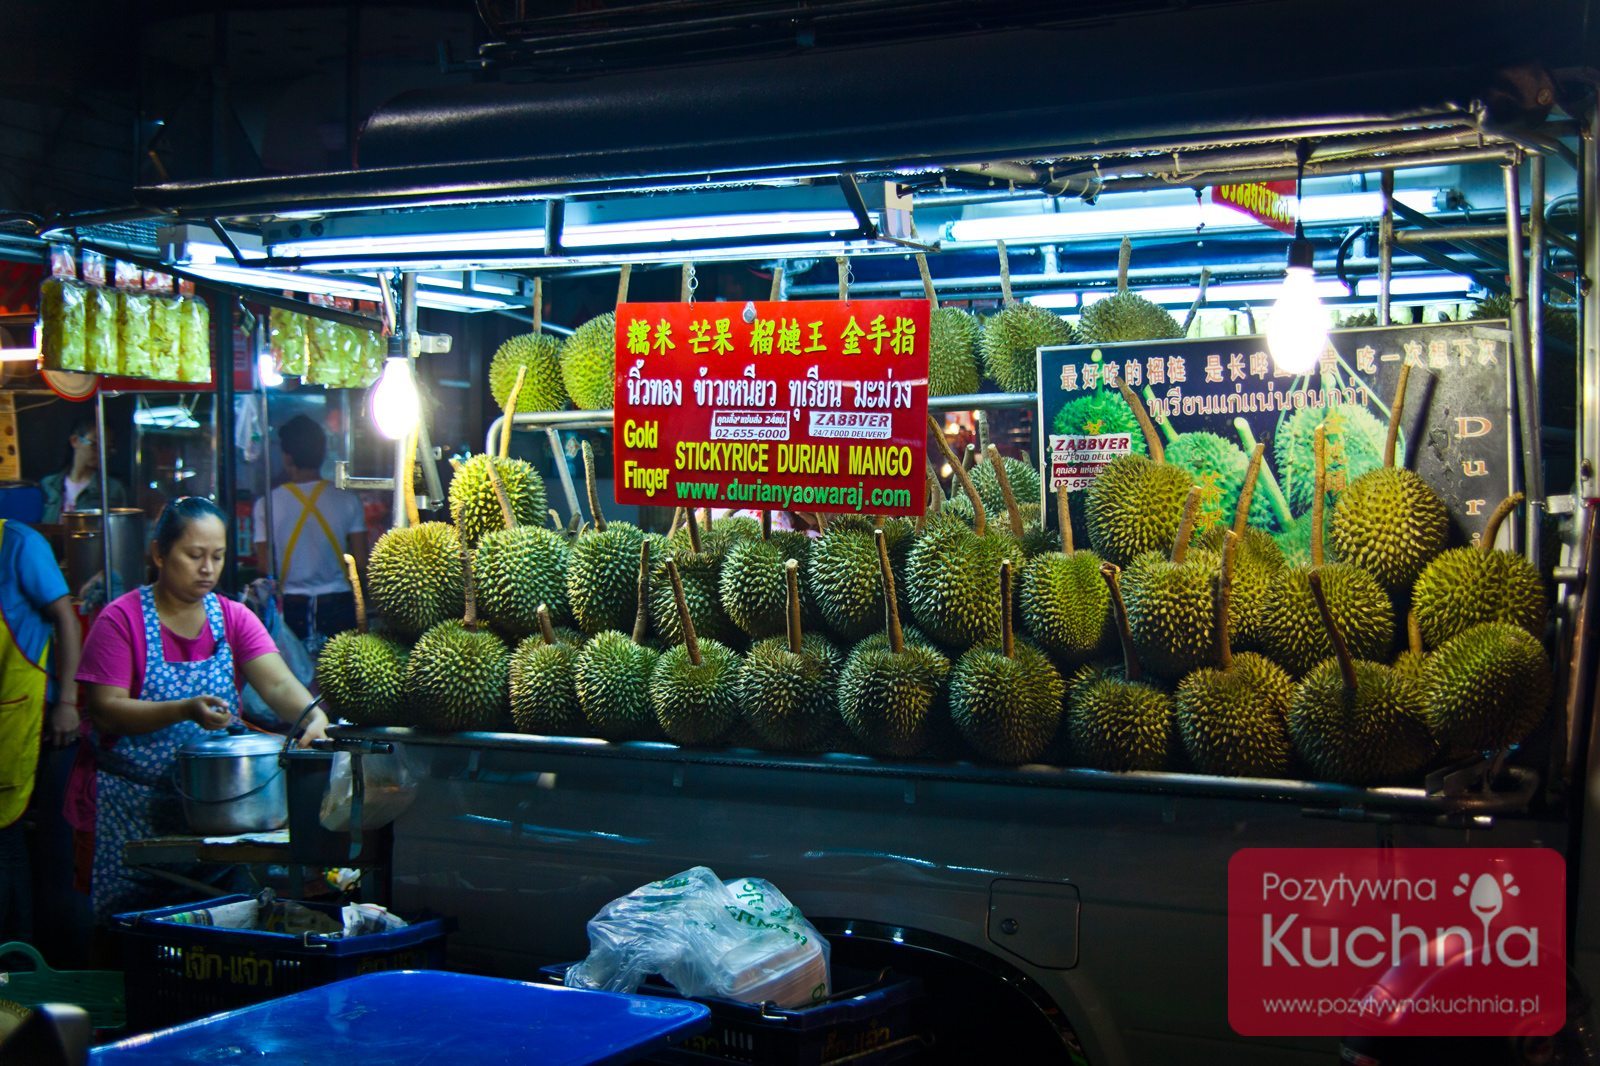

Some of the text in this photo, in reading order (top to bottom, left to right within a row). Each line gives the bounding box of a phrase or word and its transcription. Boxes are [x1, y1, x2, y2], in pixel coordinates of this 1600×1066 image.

[627, 318, 675, 356] 糯米
[688, 318, 734, 356] 芒果
[840, 314, 916, 356] 金手指
[627, 359, 912, 421] นิ้วทอง ข้าวเหนียว ทุเรียน มะม่วง
[1146, 376, 1369, 425] ทุเรียนแก่แน่นอนกว่า
[624, 418, 658, 449] Gold
[715, 428, 787, 439] 02-655-6000
[813, 429, 888, 439] 24/7 FOOD DELIVERY
[814, 413, 890, 428] ZABBVER
[675, 441, 912, 477] STICKYRICE DURIAN MANGO
[1054, 437, 1129, 451] ZABBVER
[624, 460, 669, 497] Finger
[675, 477, 911, 511] www.durianyaowaraj.com
